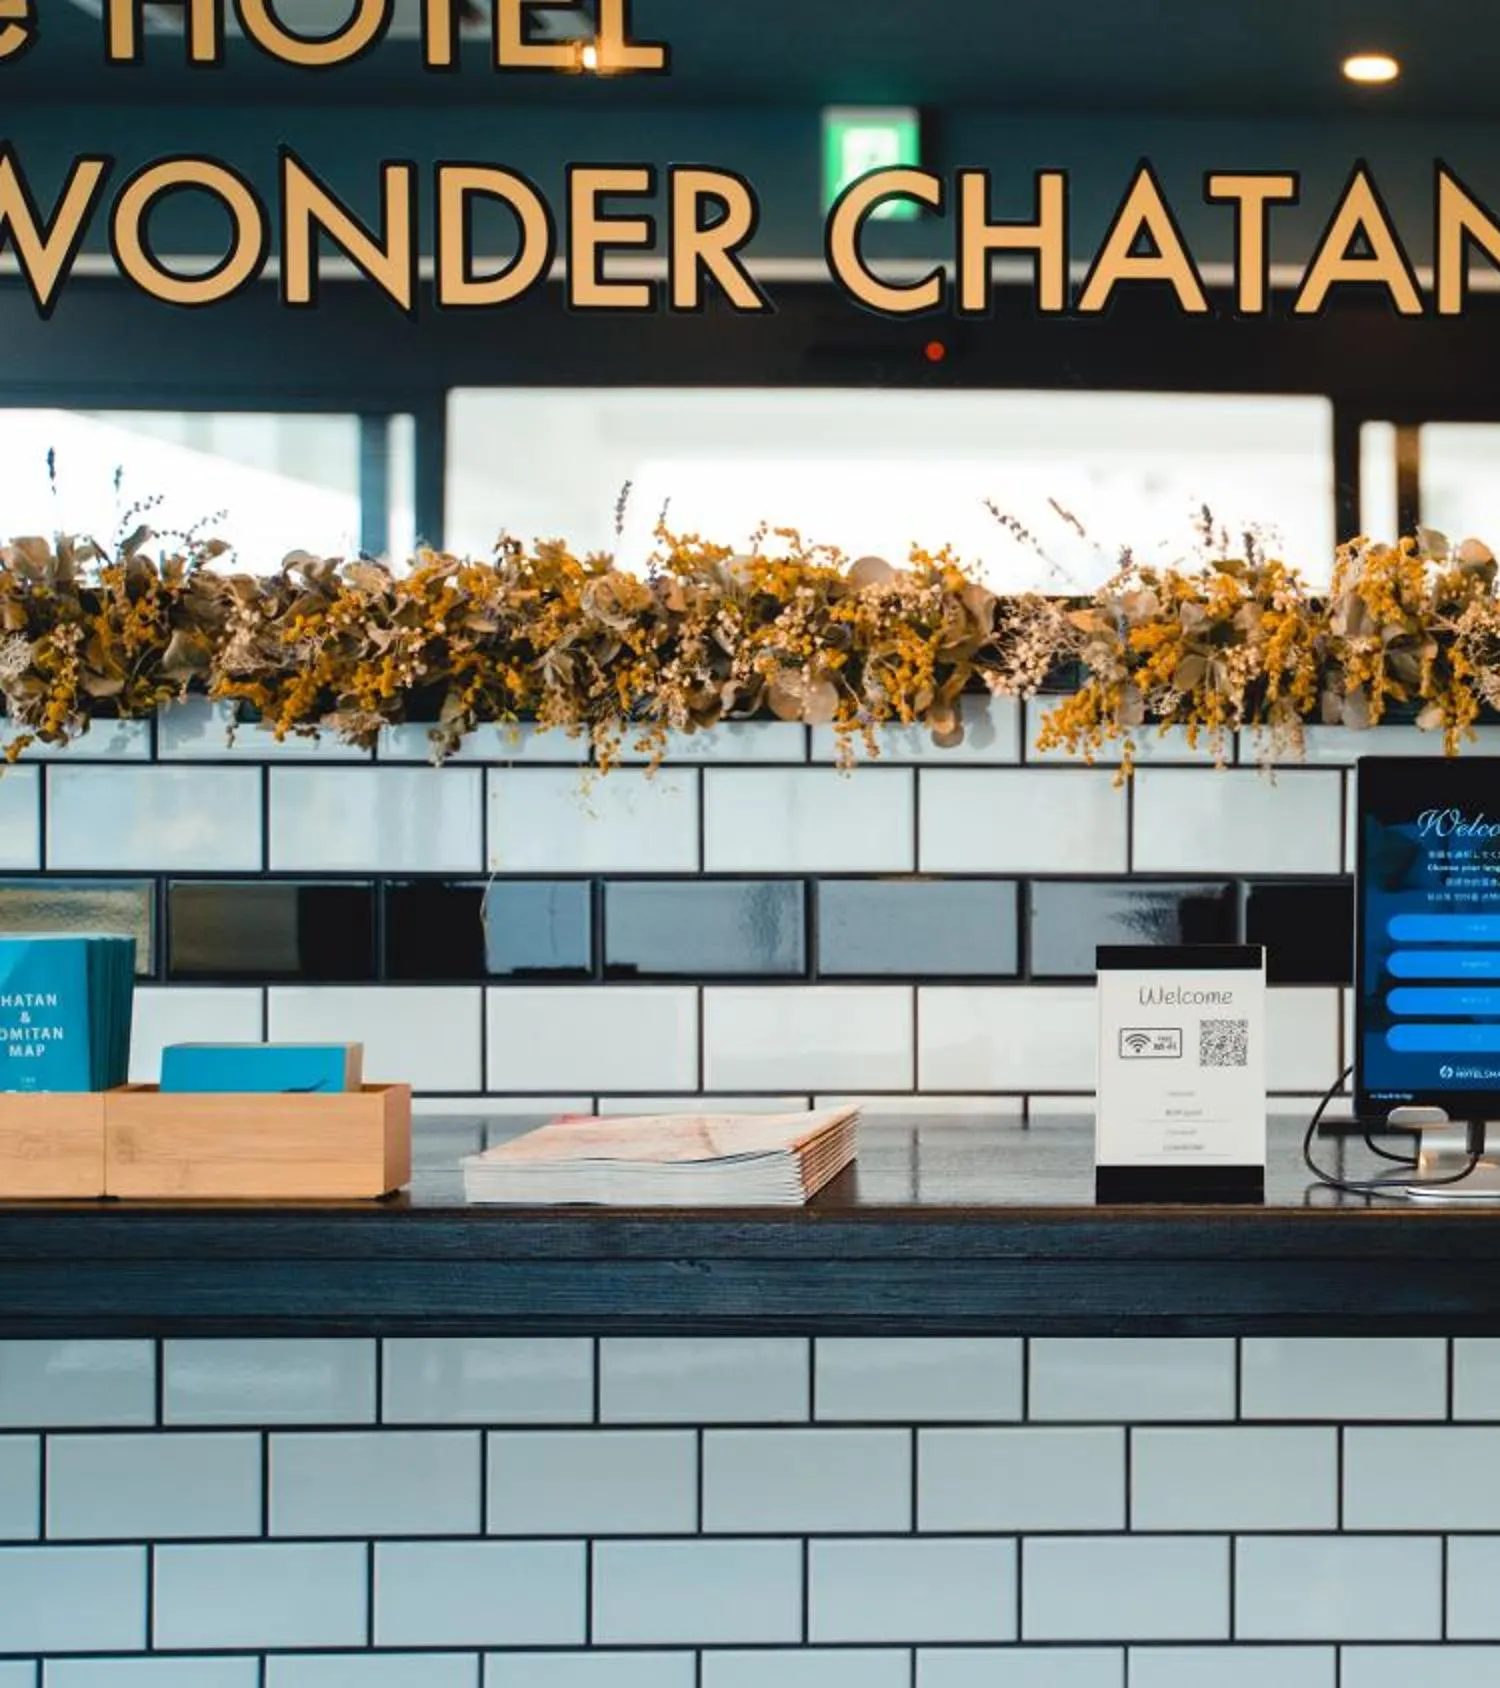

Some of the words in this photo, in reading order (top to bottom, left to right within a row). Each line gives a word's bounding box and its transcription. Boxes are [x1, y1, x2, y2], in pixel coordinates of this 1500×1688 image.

[0, 142, 774, 318] WONDER
[1138, 985, 1233, 1007] Welcome
[19, 1010, 31, 1024] &
[8, 1043, 46, 1057] MAP
